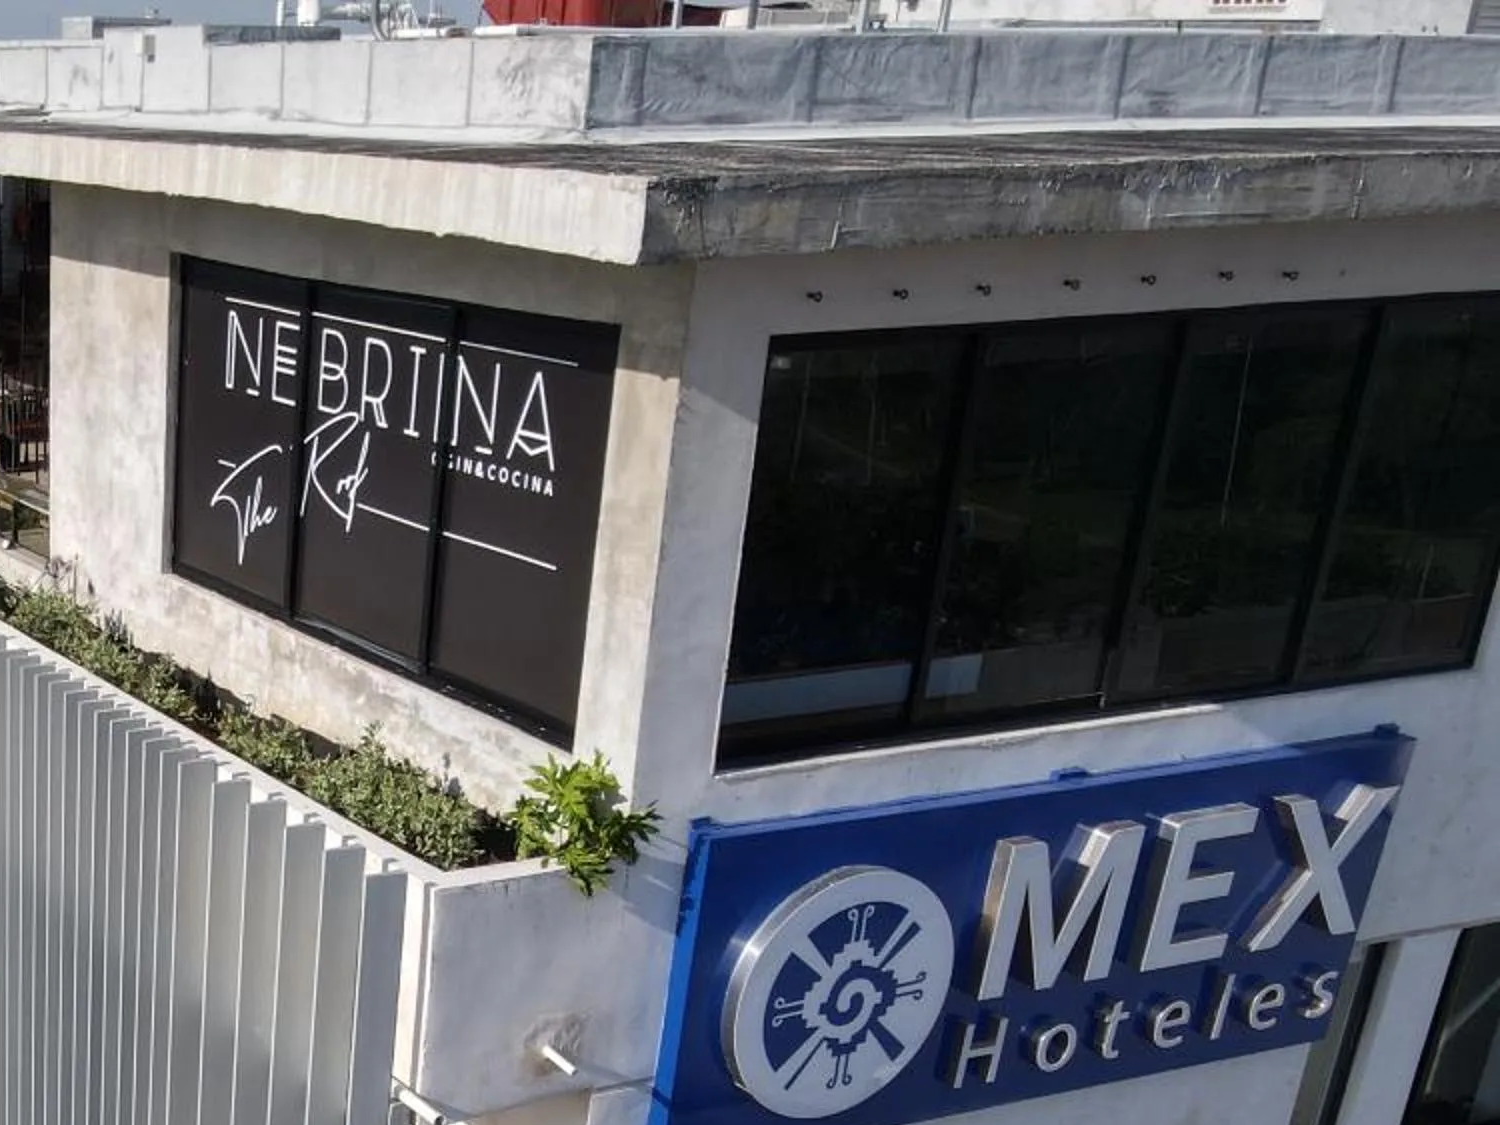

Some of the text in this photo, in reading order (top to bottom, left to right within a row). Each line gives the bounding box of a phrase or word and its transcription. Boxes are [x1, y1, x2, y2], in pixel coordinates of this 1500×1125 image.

[210, 444, 284, 565] The
[974, 783, 1400, 1001] MEX
[946, 968, 1339, 1090] Hoteles
